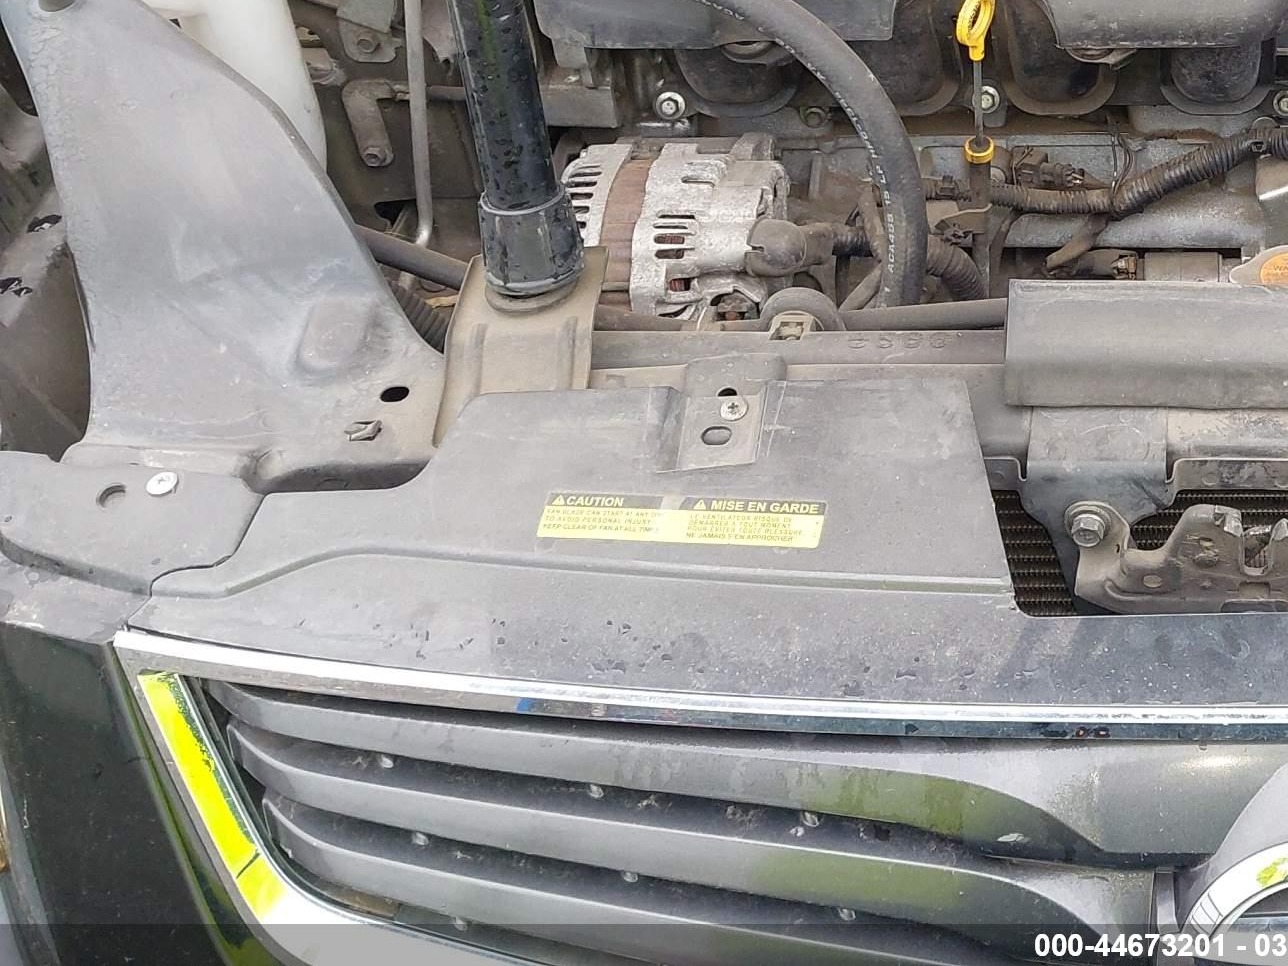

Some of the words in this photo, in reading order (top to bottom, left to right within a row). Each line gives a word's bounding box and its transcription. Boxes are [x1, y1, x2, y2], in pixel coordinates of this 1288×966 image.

[566, 496, 624, 507] CAUTION
[711, 500, 745, 512] MISE
[747, 501, 767, 512] EN
[770, 502, 820, 514] GARDE
[582, 516, 622, 524] PERSONAL
